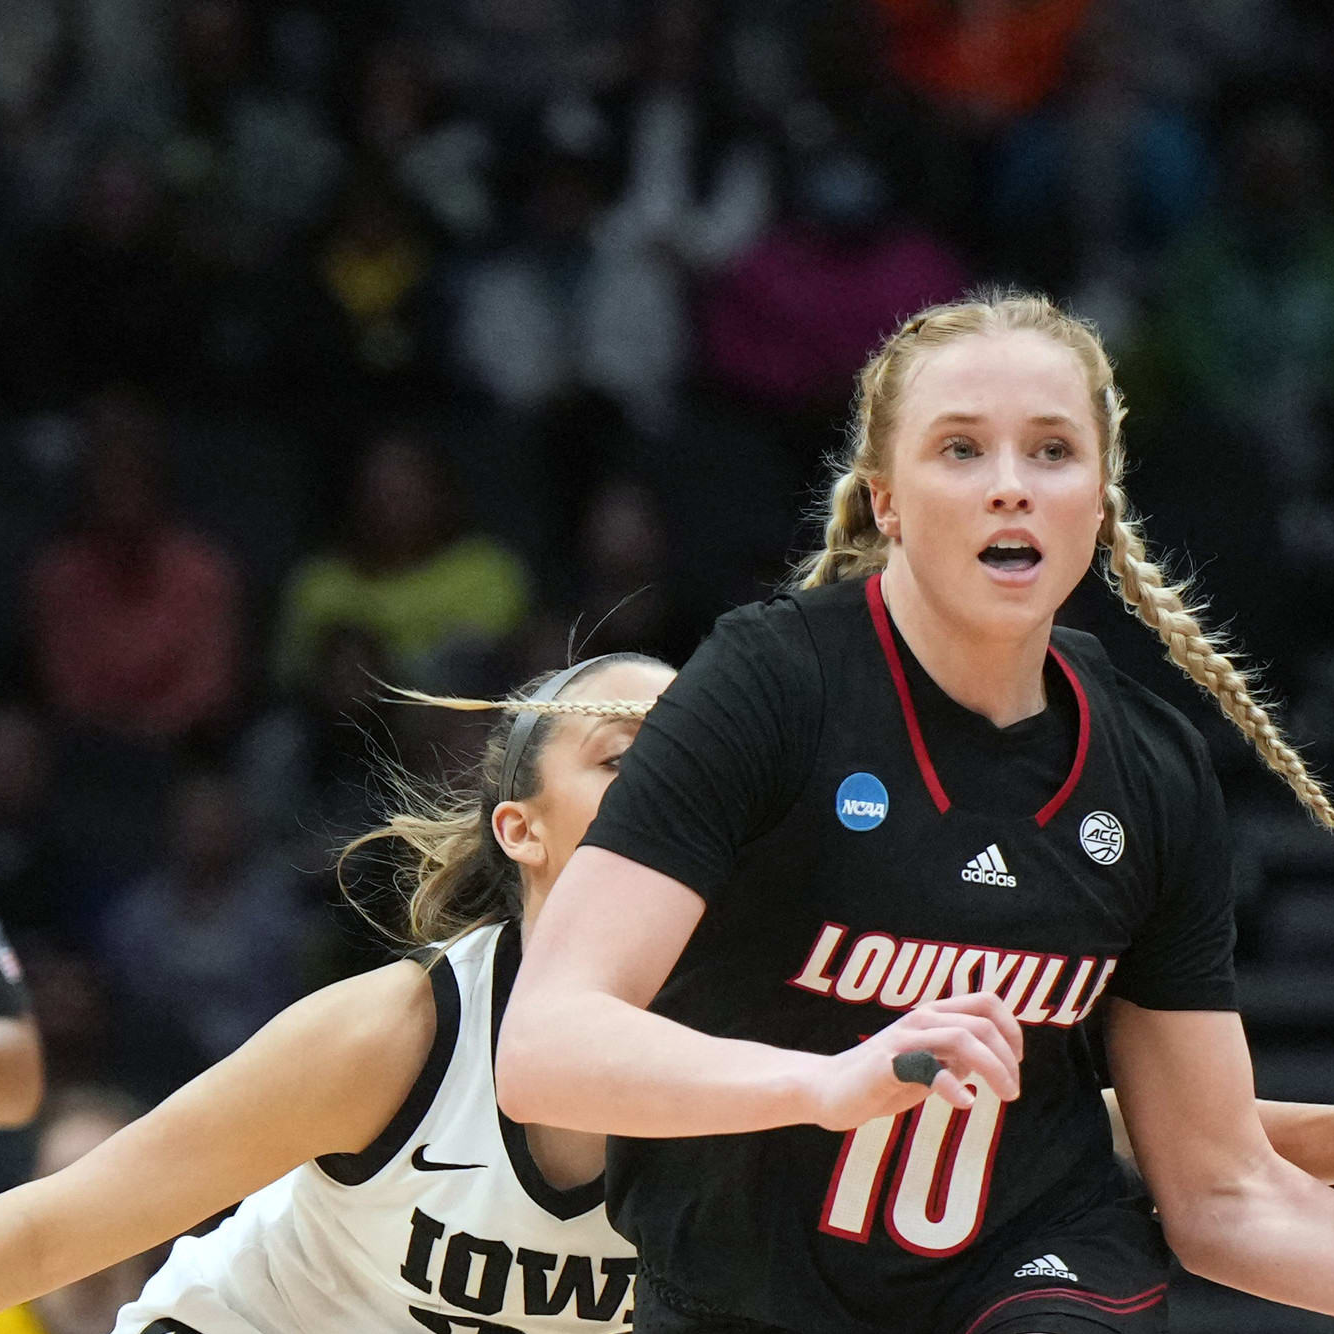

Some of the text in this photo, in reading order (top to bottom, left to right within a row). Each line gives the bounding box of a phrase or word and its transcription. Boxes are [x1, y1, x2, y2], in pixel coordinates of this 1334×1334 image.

[841, 798, 885, 819] NCAA
[1087, 828, 1121, 843] ACC
[961, 867, 1017, 888] adidas
[818, 1040, 1008, 1258] 10
[400, 1206, 638, 1323] IOW
[1014, 1265, 1079, 1282] adidas
